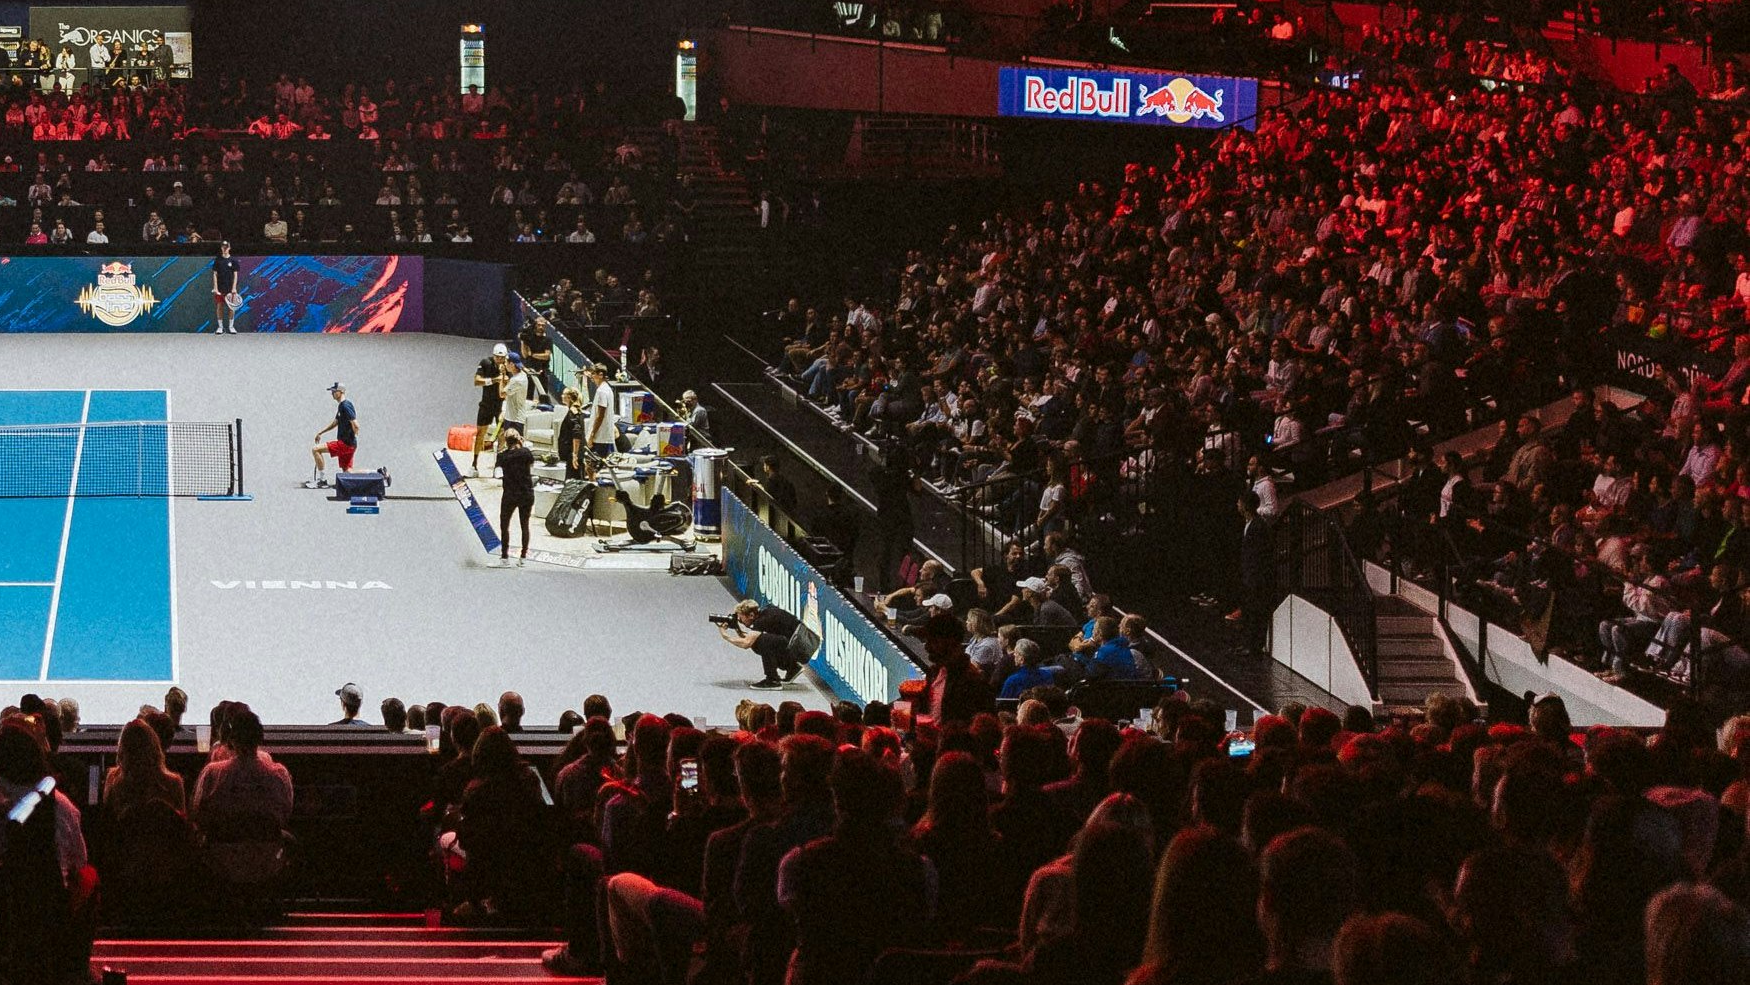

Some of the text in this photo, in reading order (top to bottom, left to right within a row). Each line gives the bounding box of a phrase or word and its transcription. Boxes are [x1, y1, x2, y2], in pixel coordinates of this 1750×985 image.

[72, 27, 161, 46] ORGANICS
[1025, 77, 1129, 115] Red Bull
[210, 580, 394, 590] VIENNA
[825, 609, 888, 706] NISHIKORI
